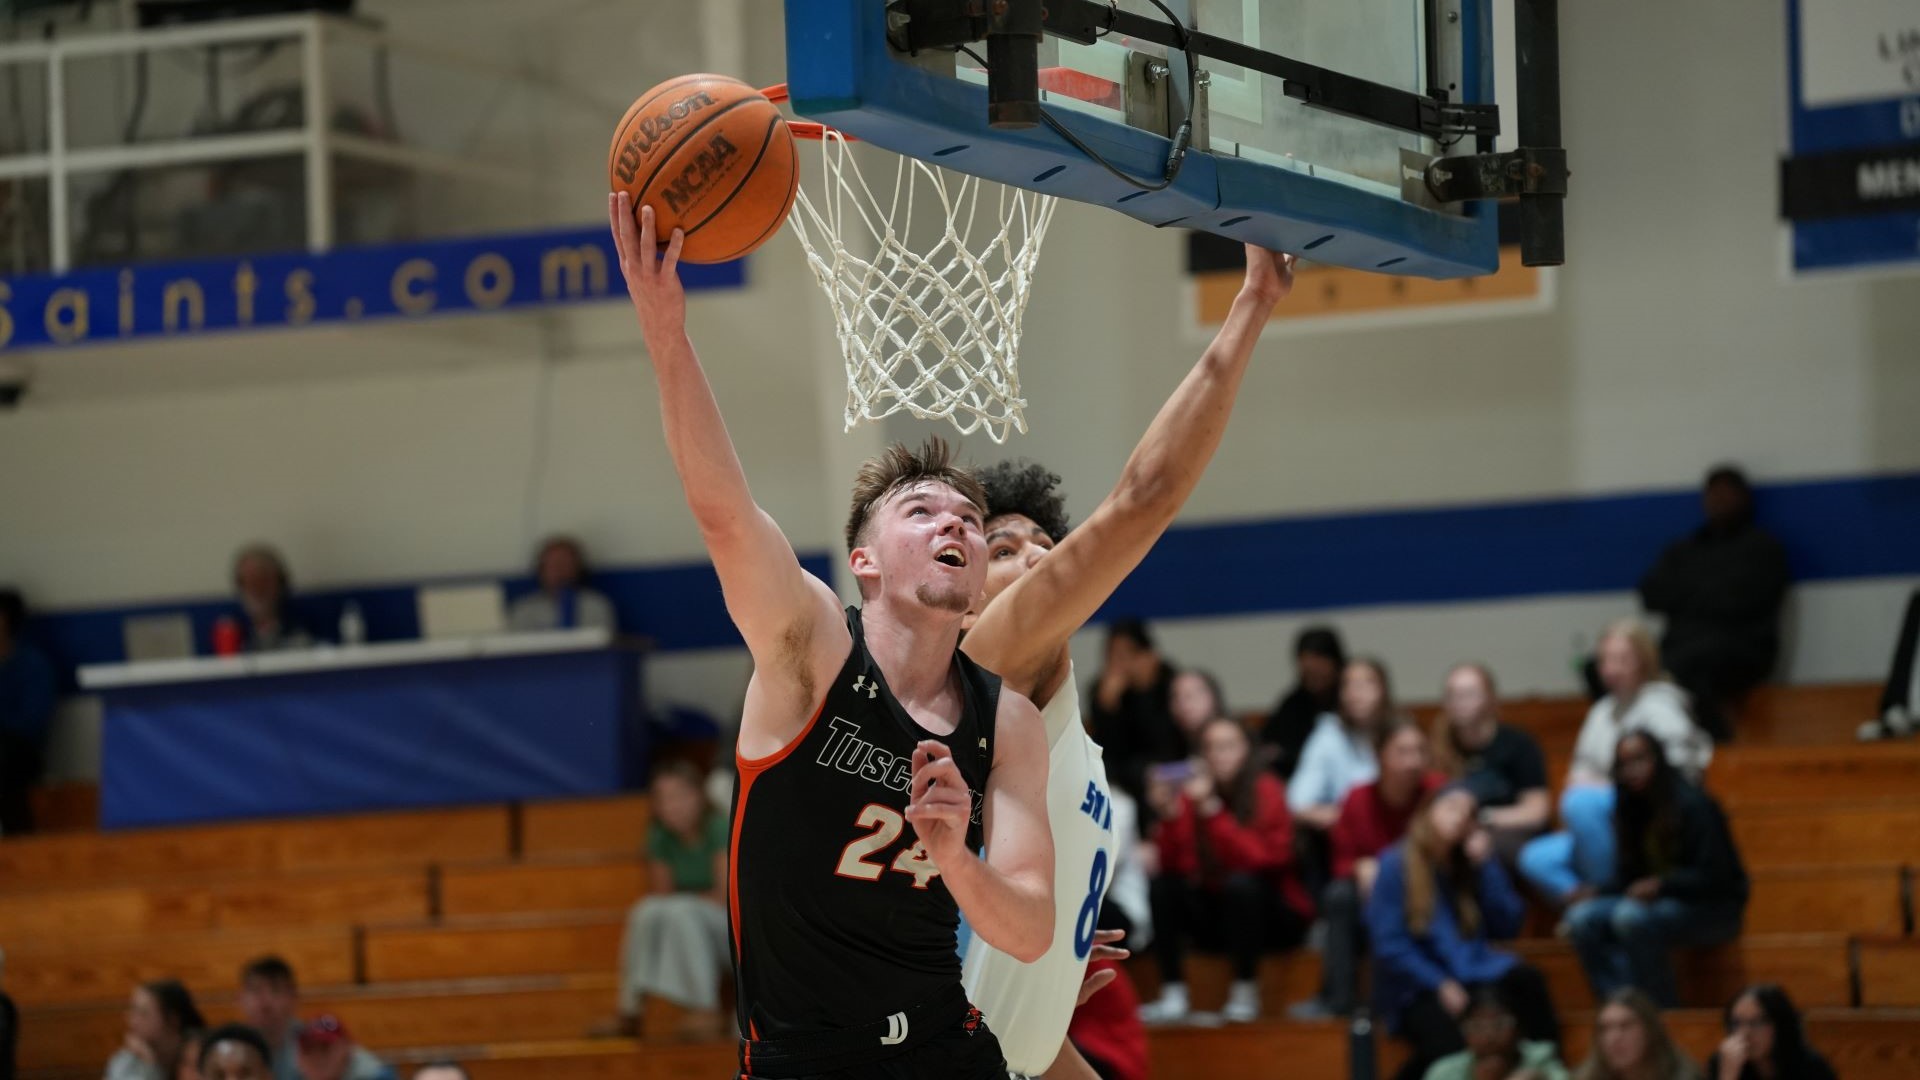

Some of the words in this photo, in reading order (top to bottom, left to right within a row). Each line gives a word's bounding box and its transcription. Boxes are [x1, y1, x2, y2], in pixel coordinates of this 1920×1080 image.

[615, 91, 715, 184] Wilson
[660, 133, 737, 214] NCAA
[834, 803, 940, 889] 24
[1074, 848, 1107, 960] 8
